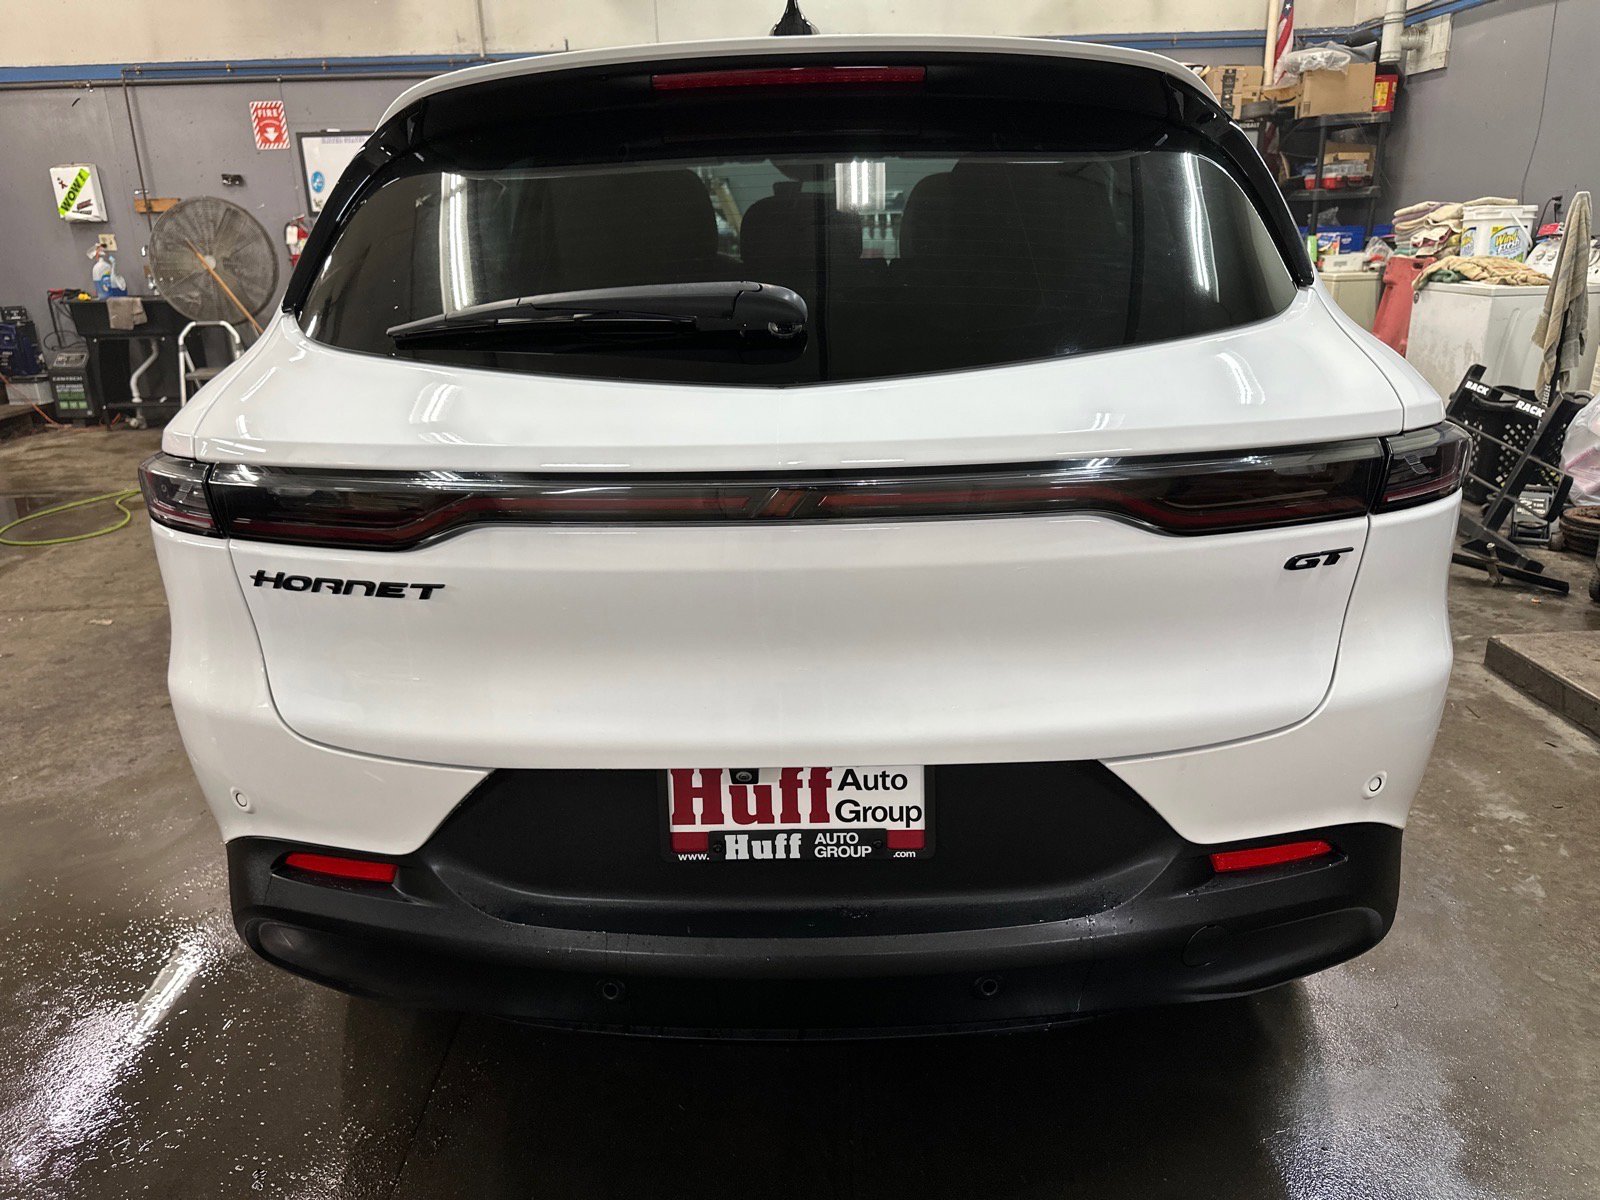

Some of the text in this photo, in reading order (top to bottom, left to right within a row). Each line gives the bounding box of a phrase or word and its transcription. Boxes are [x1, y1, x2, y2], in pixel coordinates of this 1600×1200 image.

[257, 108, 279, 118] FIRE
[1515, 400, 1546, 418] RACK
[1283, 546, 1354, 570] GT
[250, 569, 446, 600] HORNET
[837, 768, 908, 792] Auto
[670, 767, 832, 826] Huff
[835, 798, 923, 829] Group
[678, 833, 802, 861] www. Huff
[814, 832, 859, 845] AUTO
[814, 845, 872, 859] GROUP
[893, 850, 916, 859] .com
